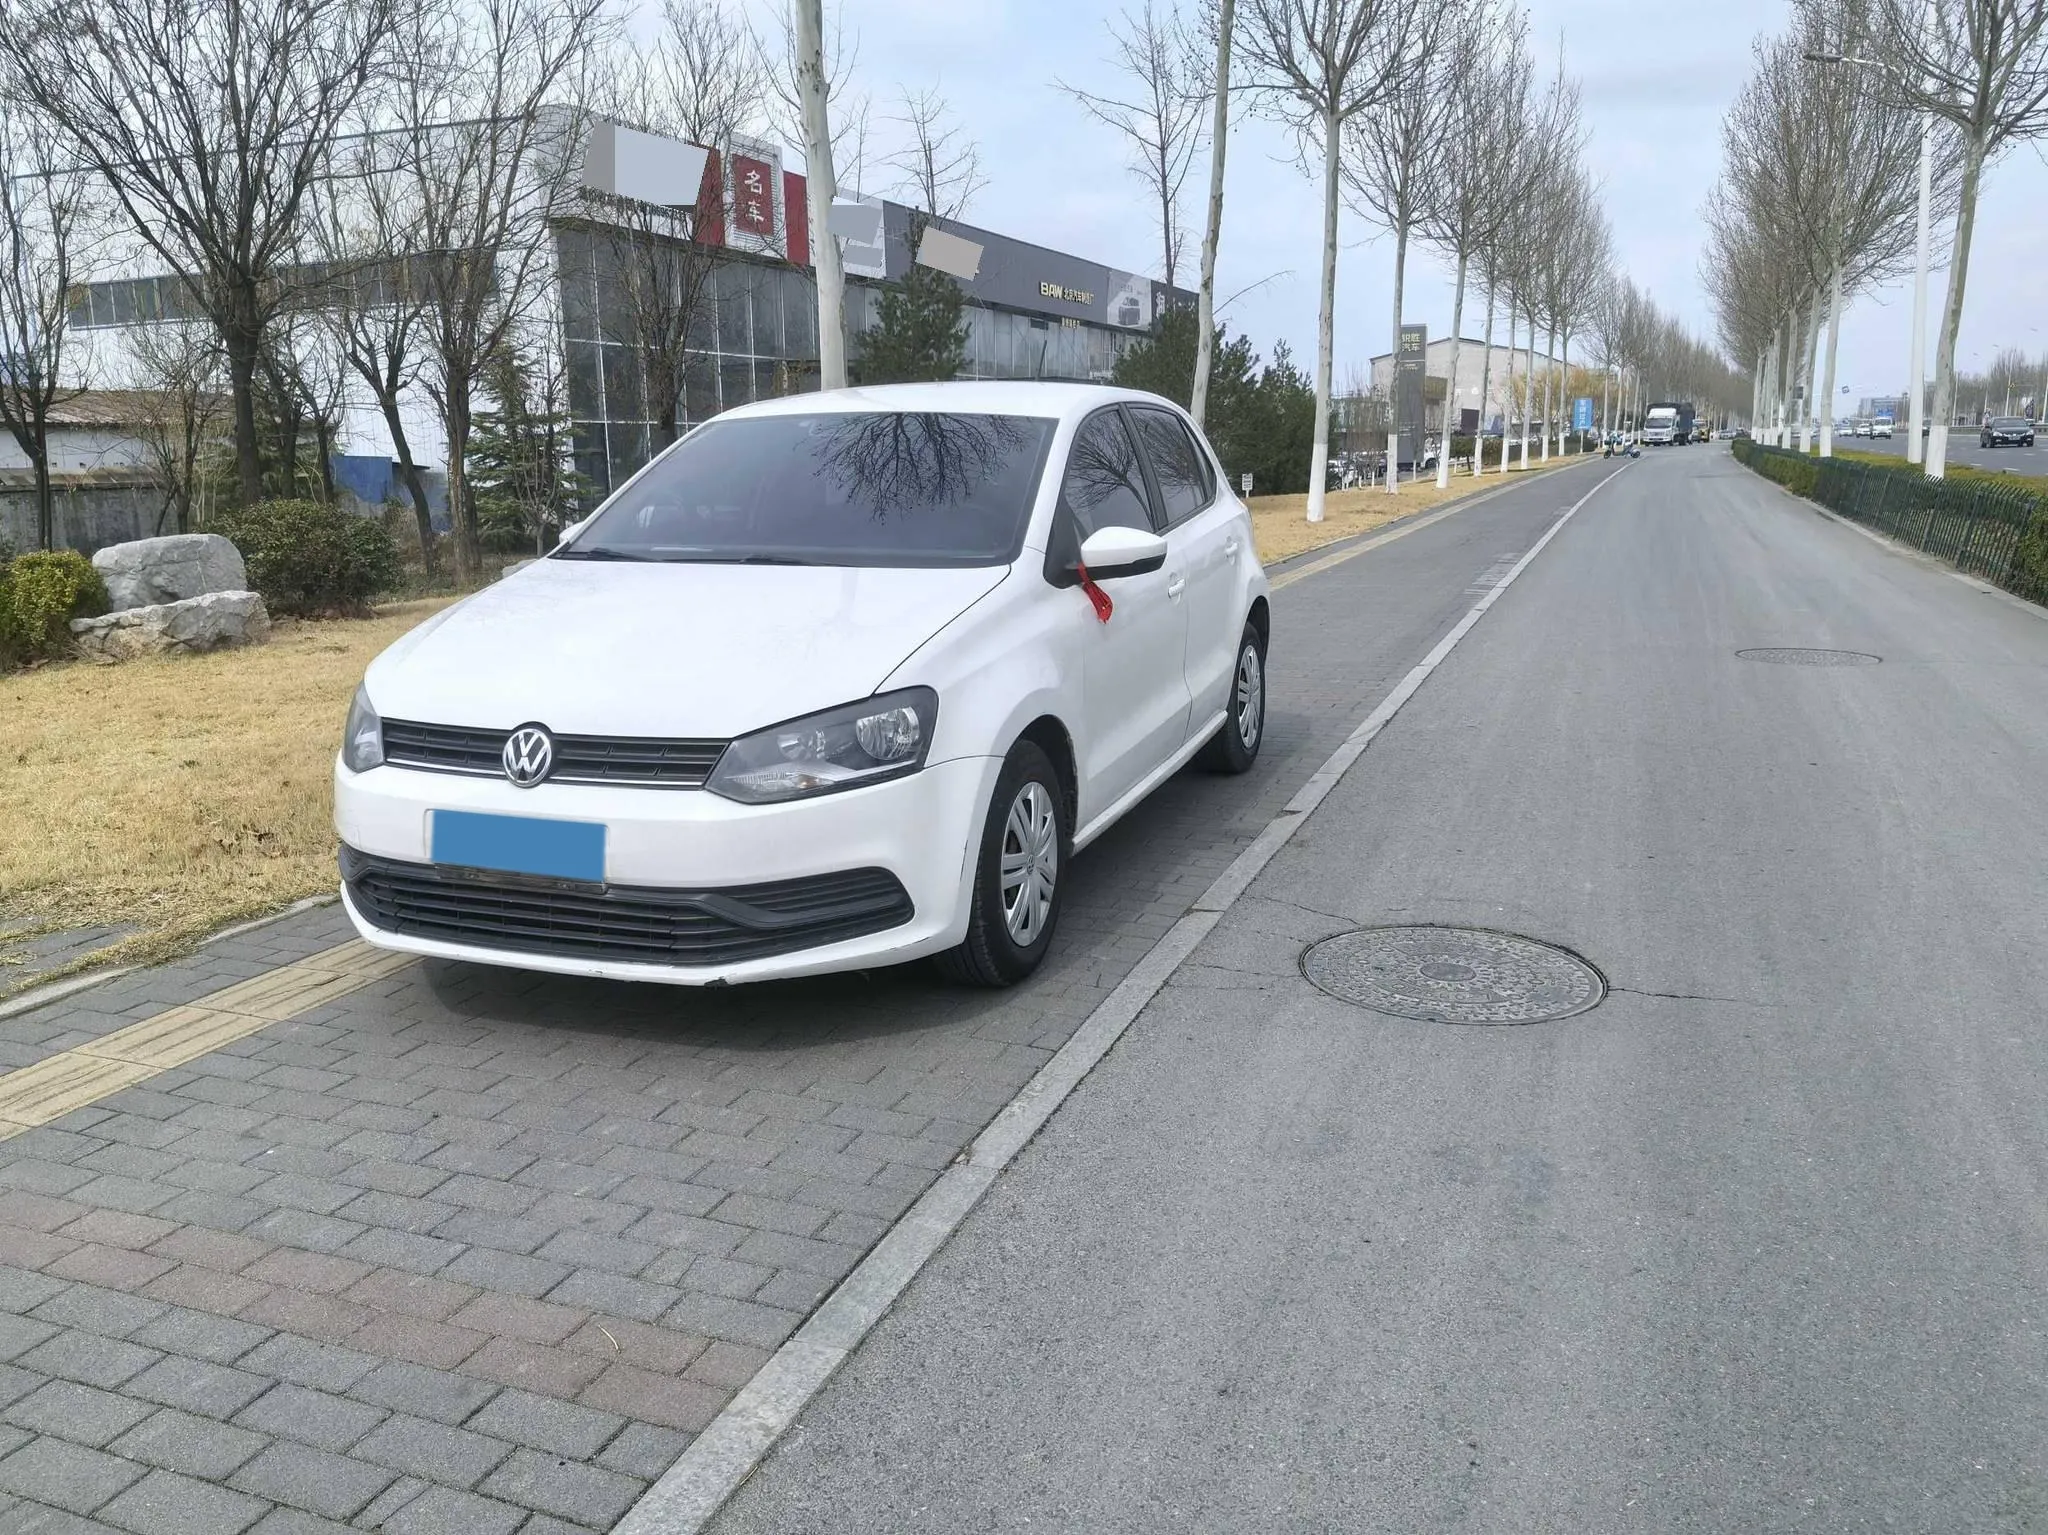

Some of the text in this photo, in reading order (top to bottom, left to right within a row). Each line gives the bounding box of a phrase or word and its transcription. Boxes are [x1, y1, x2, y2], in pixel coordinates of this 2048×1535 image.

[744, 170, 764, 222] 名车
[1041, 282, 1063, 299] BAW
[1401, 342, 1421, 352] 汽车
